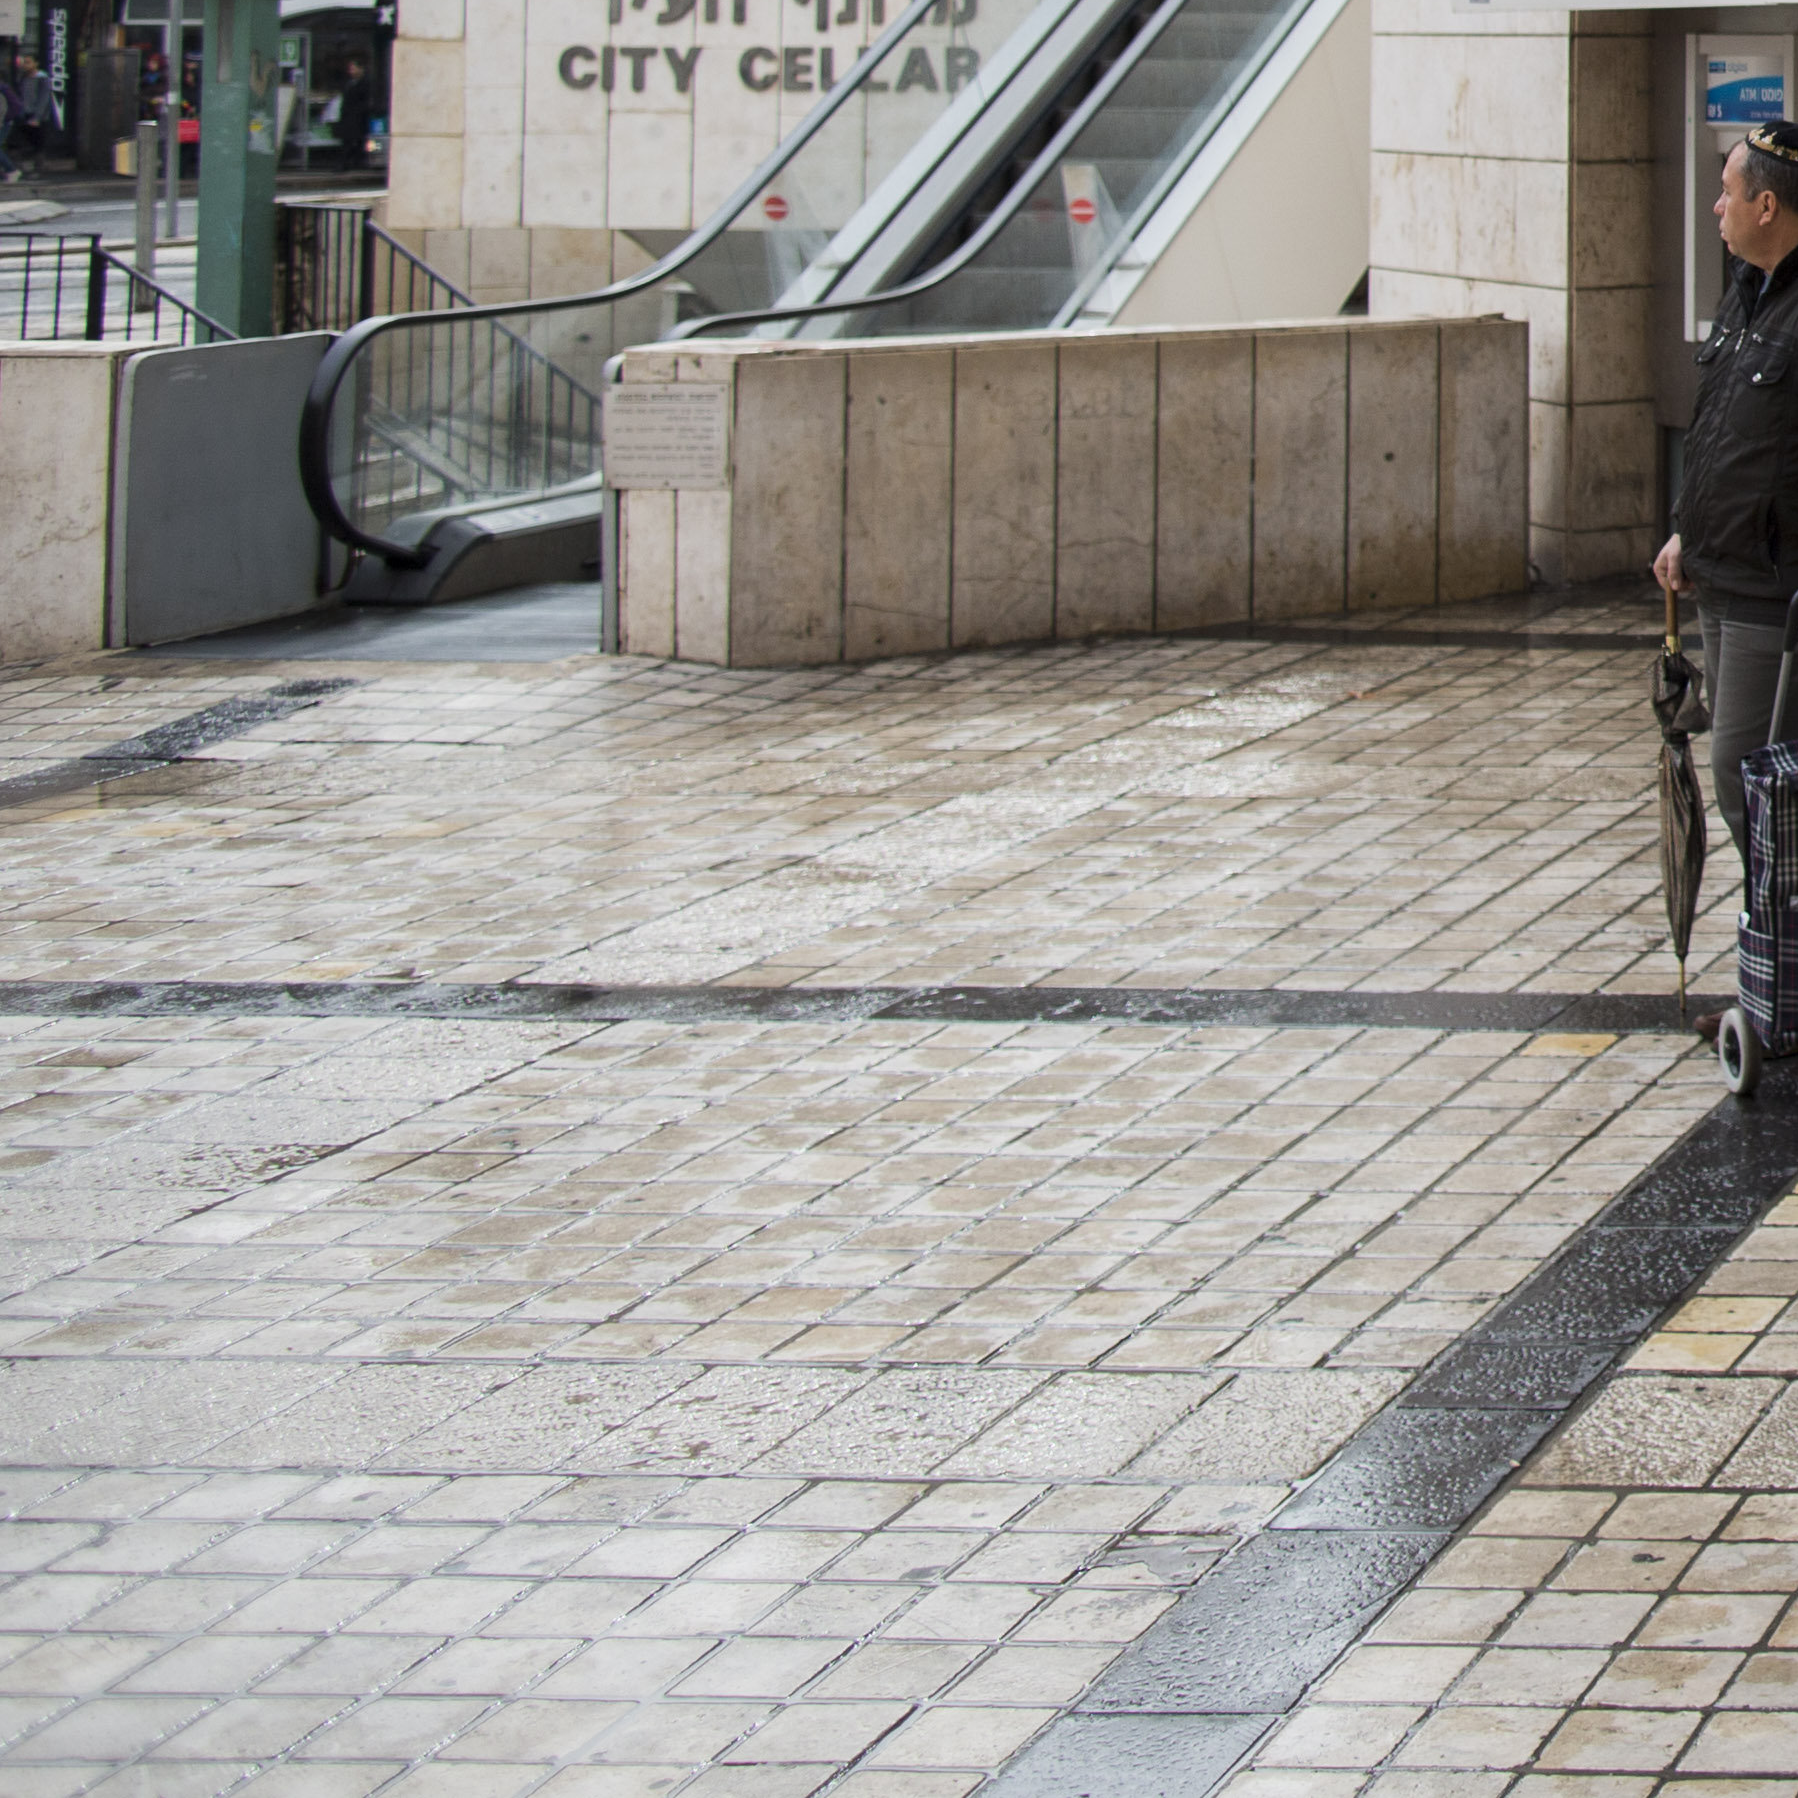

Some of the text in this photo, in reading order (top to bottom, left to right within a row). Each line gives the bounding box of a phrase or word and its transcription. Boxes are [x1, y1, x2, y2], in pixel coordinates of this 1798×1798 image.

[48, 8, 69, 91] speedo
[558, 46, 980, 94] CITY CELLAR
[1739, 88, 1757, 101] ATM
